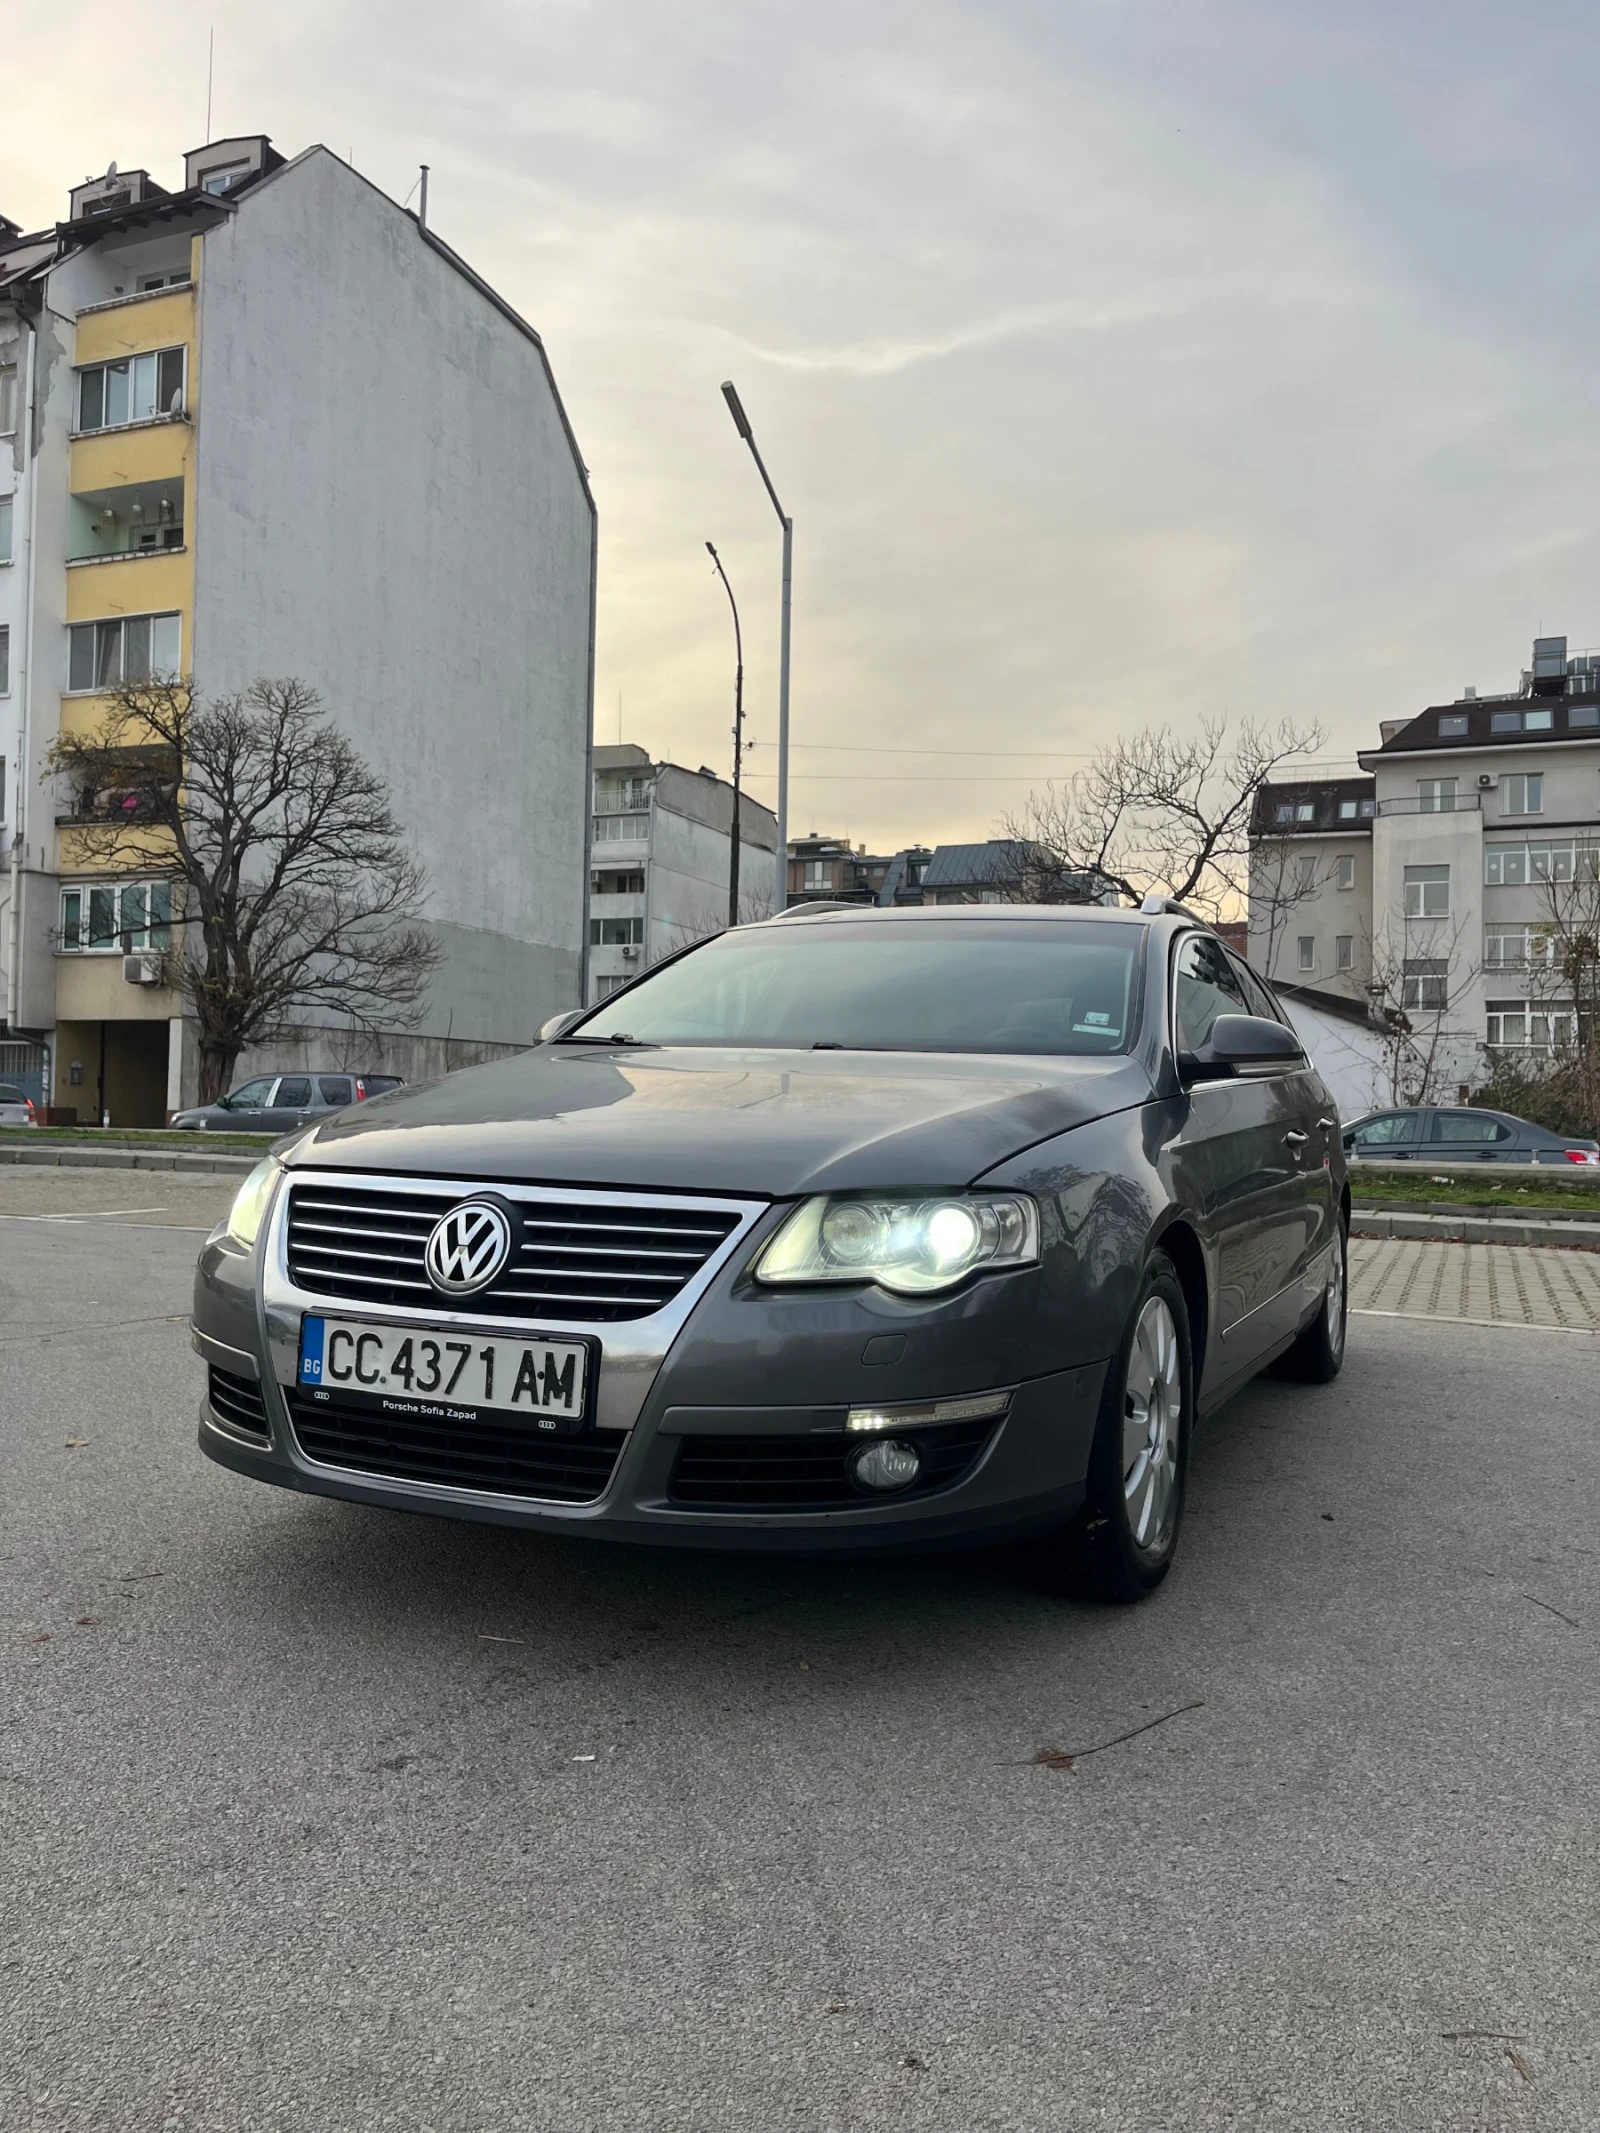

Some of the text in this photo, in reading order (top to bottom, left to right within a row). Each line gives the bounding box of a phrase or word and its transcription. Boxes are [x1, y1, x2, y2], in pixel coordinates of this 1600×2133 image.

[303, 1358, 321, 1375] BG
[390, 1337, 495, 1400] 4371
[382, 1400, 477, 1421] Porsche Sofia Zapad
